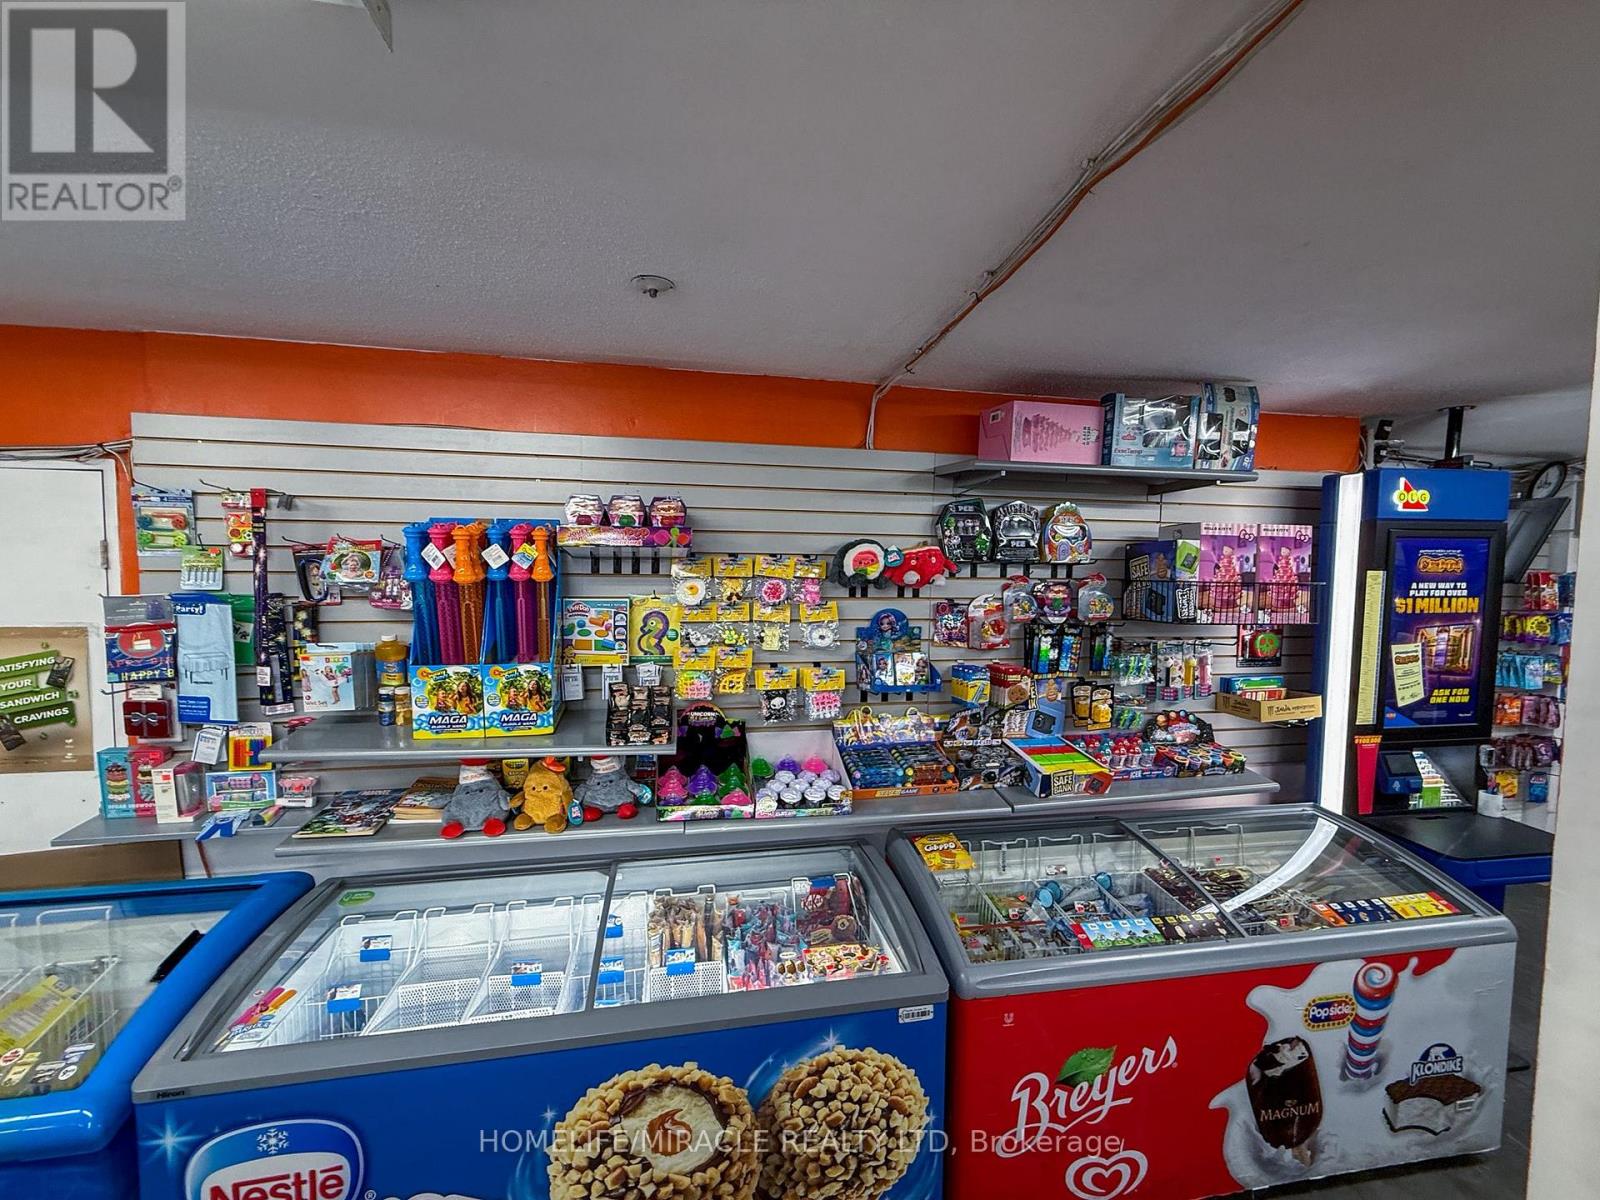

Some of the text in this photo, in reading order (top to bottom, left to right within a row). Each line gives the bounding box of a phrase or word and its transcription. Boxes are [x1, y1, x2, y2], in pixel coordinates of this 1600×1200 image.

[1398, 493, 1427, 503] OLG
[1395, 597, 1480, 614] $1 MILLION
[0, 678, 32, 691] YOUR
[1432, 688, 1451, 696] ASK
[0, 691, 60, 709] SANDWICH
[1429, 696, 1446, 704] ONE
[13, 706, 70, 725] CRAVINGS
[429, 715, 467, 724] MAGA
[501, 713, 537, 722] MAGA
[1053, 775, 1073, 787] SAFE
[1053, 783, 1073, 794] BANK
[1411, 1056, 1464, 1087] KLONDIKE
[995, 1035, 1178, 1158] Breyers
[1259, 1101, 1320, 1123] MAGNUM
[209, 1164, 344, 1200] Nestlé
